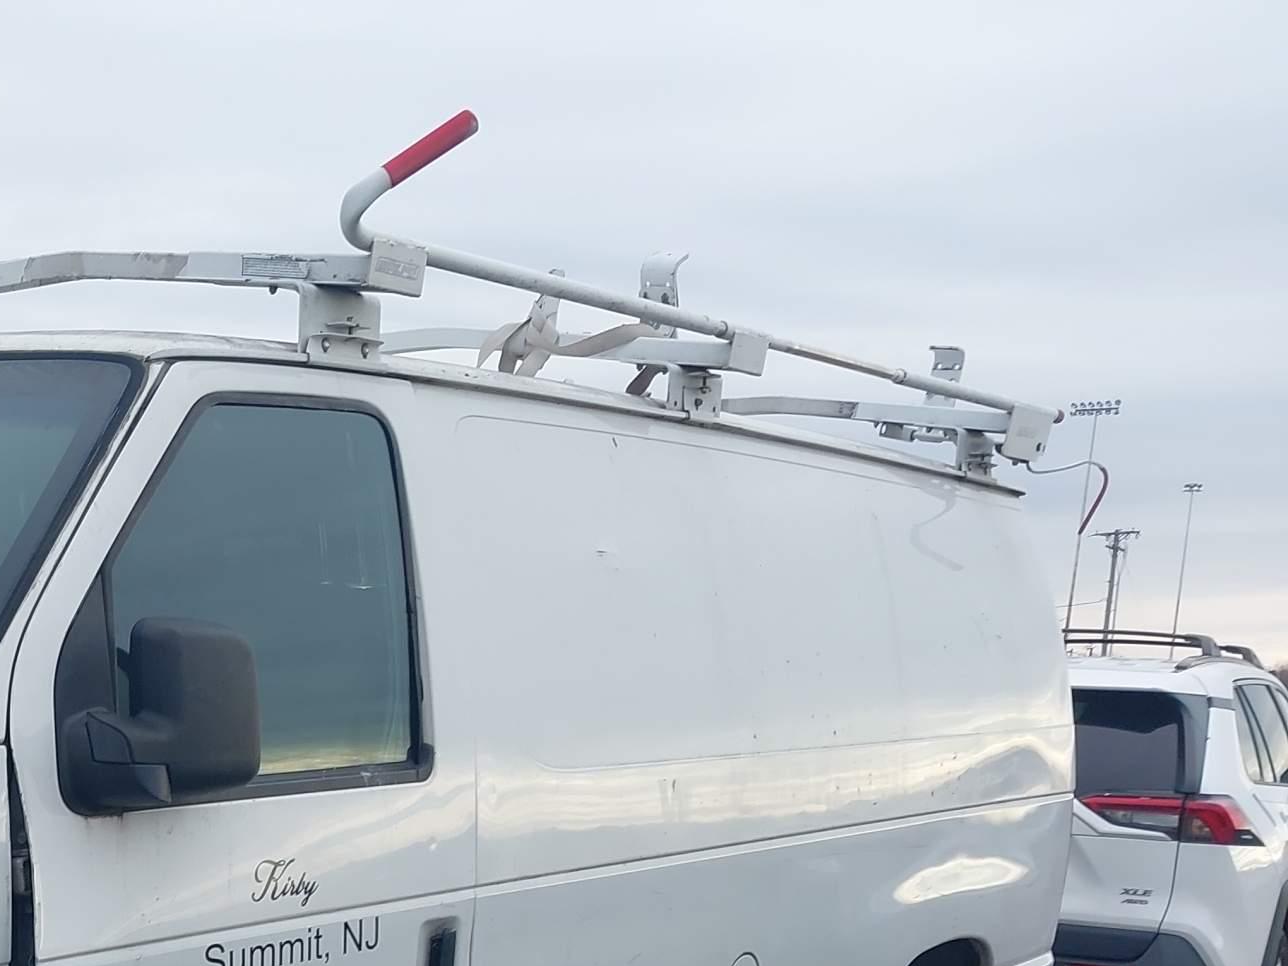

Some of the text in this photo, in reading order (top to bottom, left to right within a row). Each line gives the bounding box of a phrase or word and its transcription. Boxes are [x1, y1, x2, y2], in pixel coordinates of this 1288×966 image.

[251, 858, 319, 907] Kirby
[1120, 888, 1153, 897] XLE
[342, 916, 380, 955] NJ
